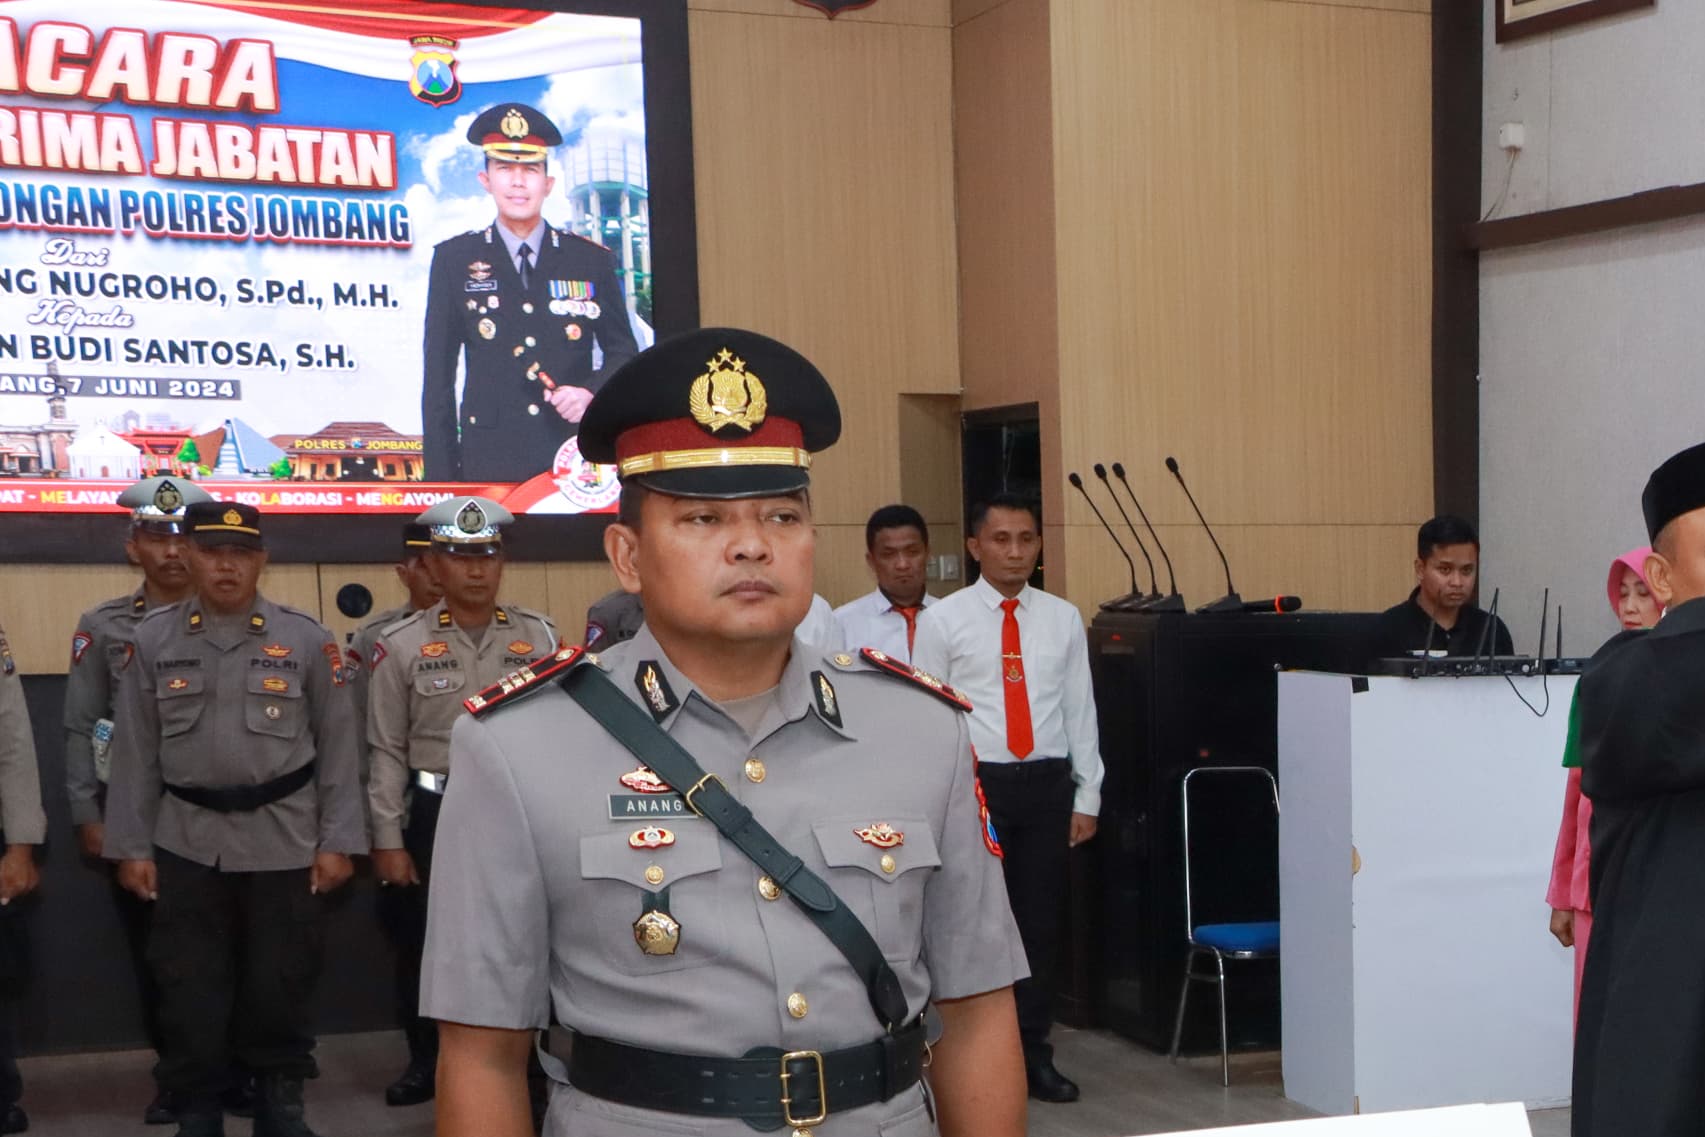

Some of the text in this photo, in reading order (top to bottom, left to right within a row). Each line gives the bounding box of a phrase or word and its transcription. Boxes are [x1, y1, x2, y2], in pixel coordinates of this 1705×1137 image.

[149, 116, 398, 190] JABATAN
[120, 188, 251, 240] POLRES
[252, 195, 413, 248] JOMBANG
[40, 237, 110, 266] Dari
[49, 270, 227, 306] NUGROHO,
[237, 279, 322, 310] S.Pd.,
[333, 282, 399, 307] M.H.
[27, 299, 134, 334] Kepada
[31, 336, 111, 362] BUDI
[124, 339, 287, 371] SANTOSA,
[297, 344, 355, 368] S.H.
[95, 378, 158, 396] JUNI
[169, 380, 235, 397] 2024
[295, 439, 423, 450] POLRES JOMBANG
[41, 491, 122, 504] MELAYA
[236, 491, 343, 505] KOLABORASI
[251, 659, 298, 670] POLRI
[418, 660, 458, 672] ANANG
[626, 800, 682, 812] ANANG
